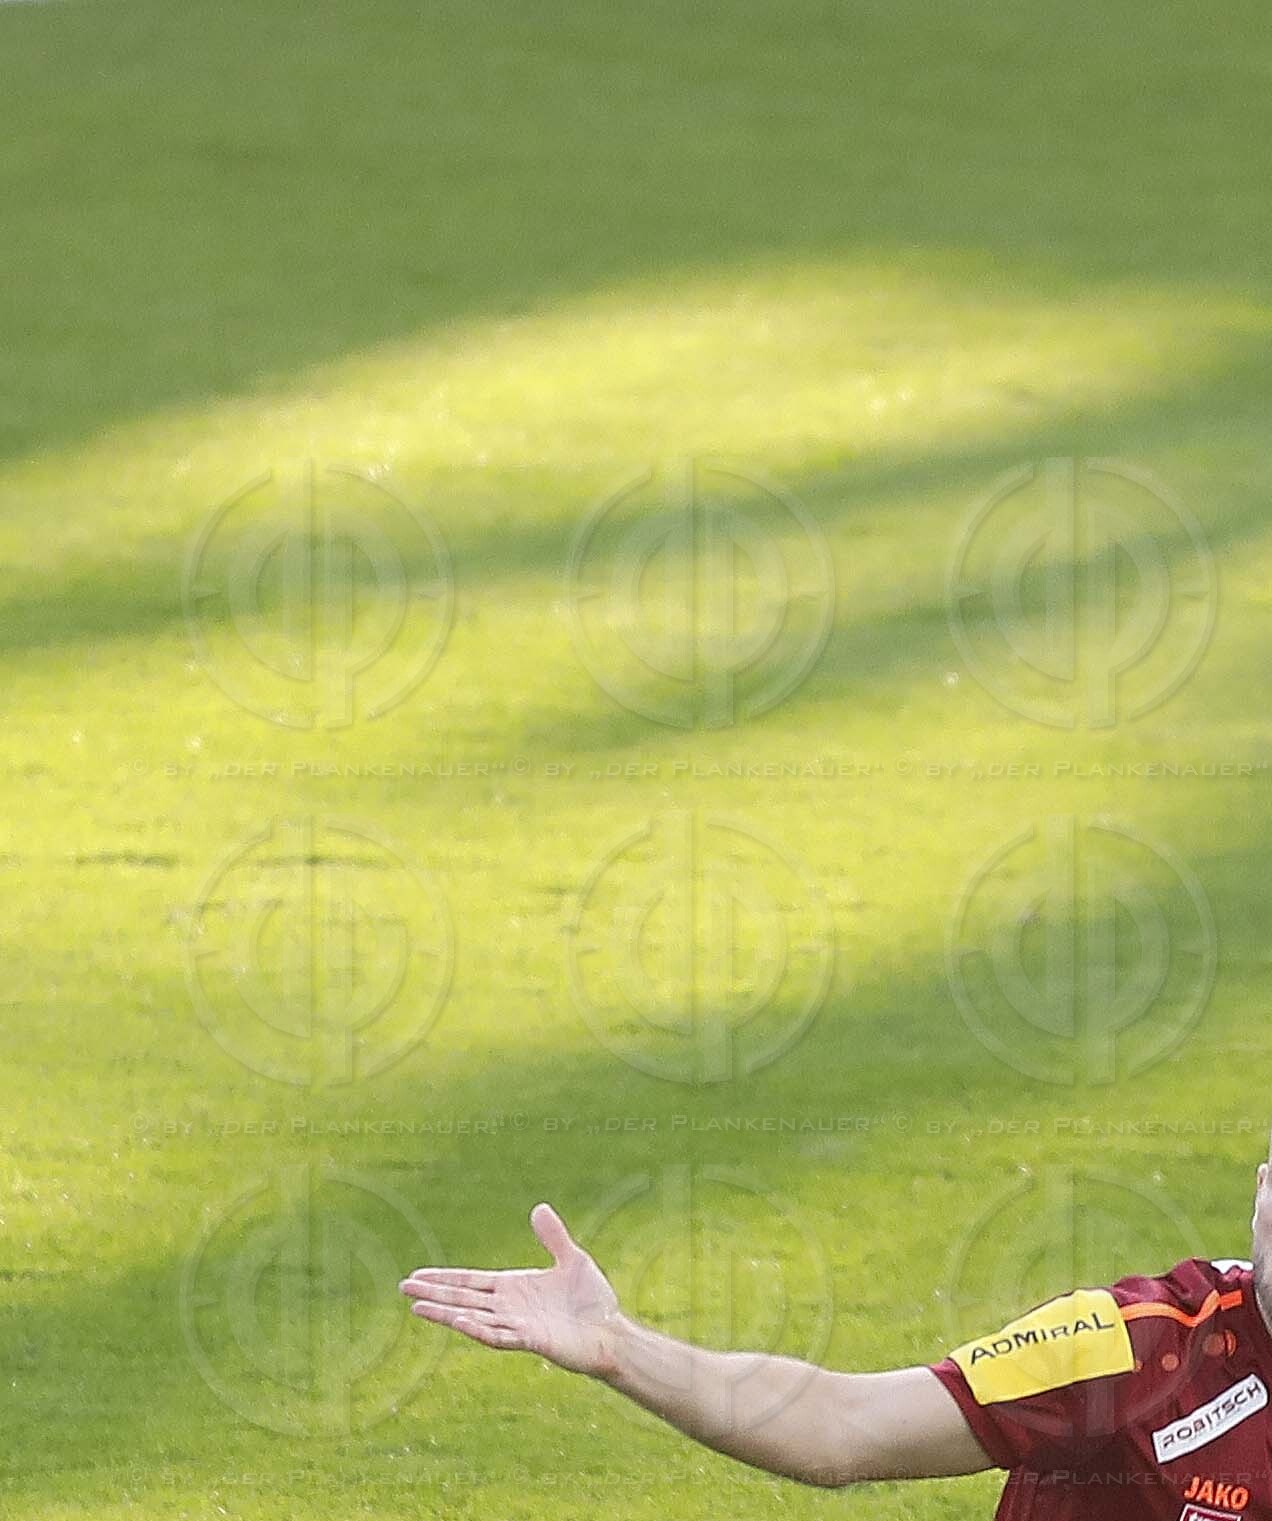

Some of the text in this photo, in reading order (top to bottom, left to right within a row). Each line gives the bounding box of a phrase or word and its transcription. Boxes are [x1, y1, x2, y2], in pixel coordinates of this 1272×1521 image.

[970, 1312, 1115, 1366] ADMIRAL
[1162, 1381, 1263, 1449] ROBITSCH
[1184, 1476, 1249, 1511] JAKO
